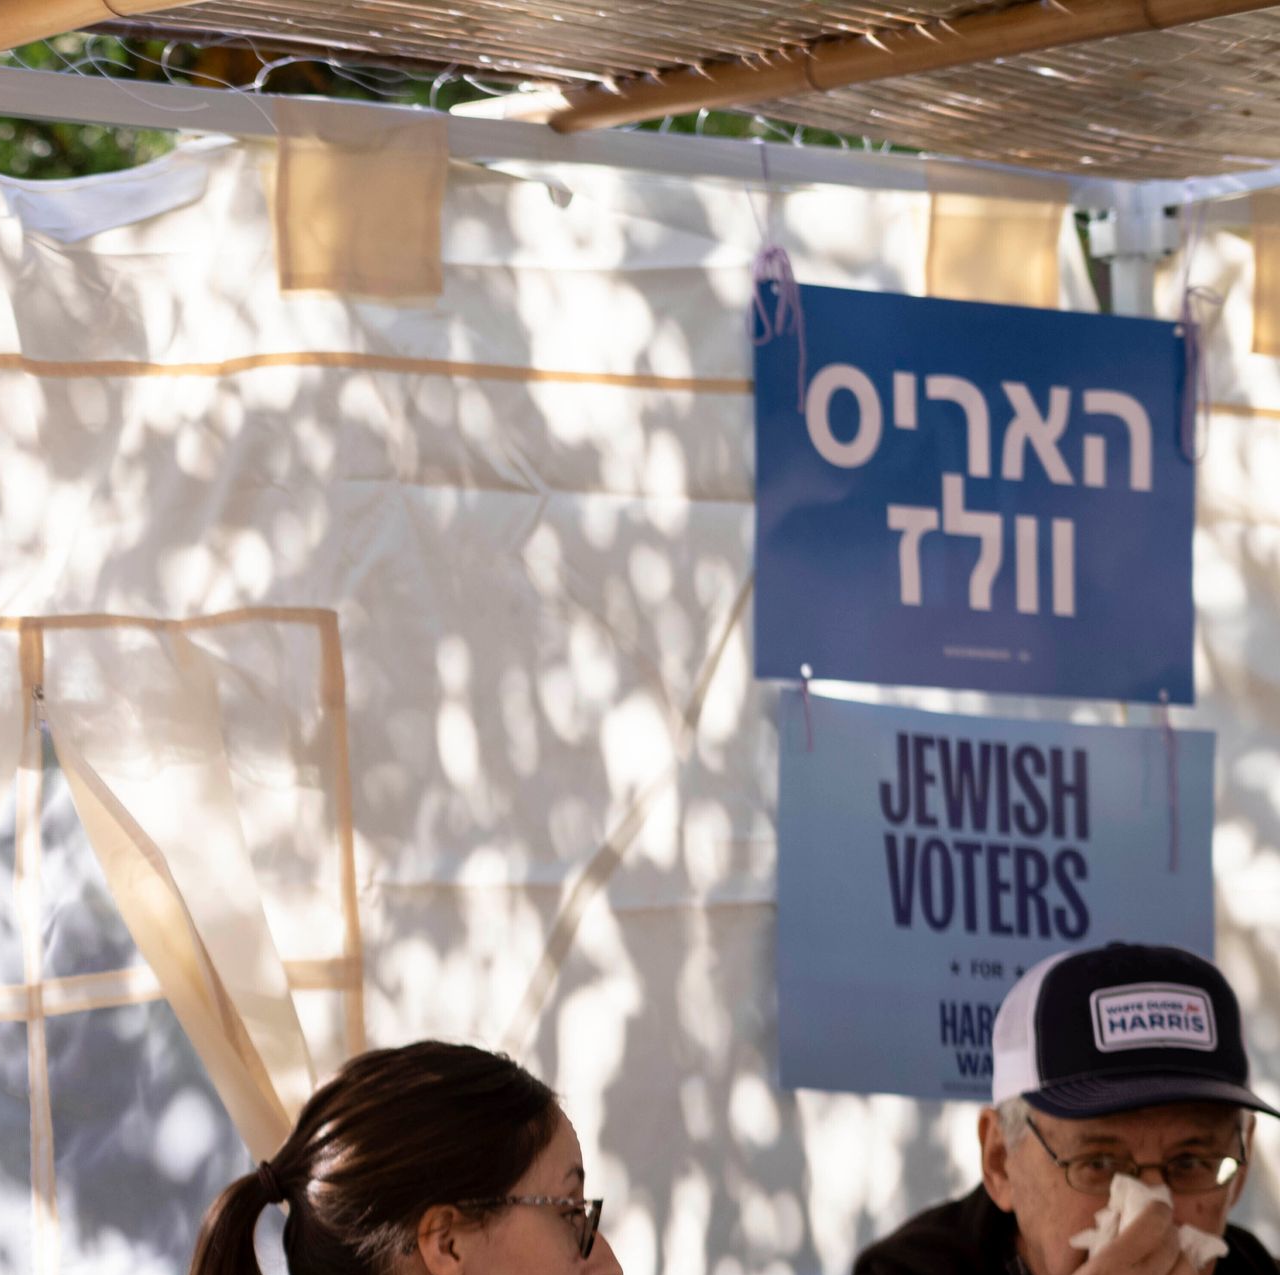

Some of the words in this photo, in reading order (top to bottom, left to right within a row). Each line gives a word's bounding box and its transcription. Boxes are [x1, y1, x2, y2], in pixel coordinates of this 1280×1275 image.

[805, 363, 1153, 492] האריס
[887, 472, 1076, 618] וולז
[879, 731, 1092, 842] JEWISH
[883, 832, 1091, 943] VOTERS
[970, 960, 1004, 980] FOR
[940, 1001, 1000, 1047] HAR
[1108, 1012, 1205, 1035] HARRIS
[956, 1051, 994, 1077] WA
